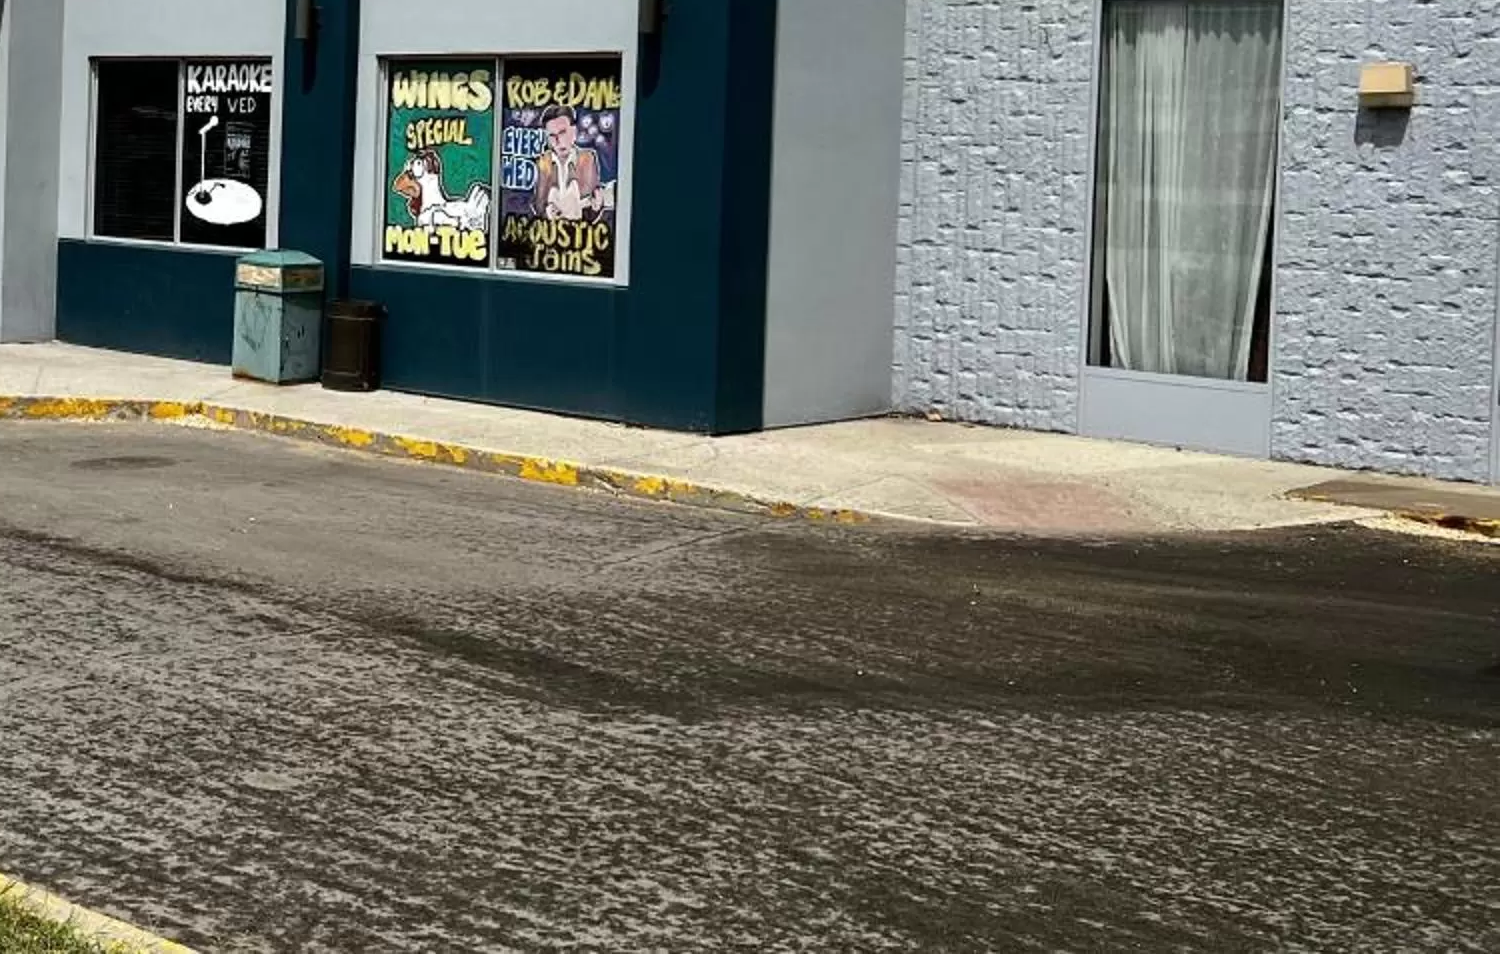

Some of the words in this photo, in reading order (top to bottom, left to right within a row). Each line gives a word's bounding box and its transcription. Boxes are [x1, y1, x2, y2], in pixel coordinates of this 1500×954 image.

[187, 64, 272, 94] KARAOKE
[392, 69, 492, 111] WINGS
[506, 76, 551, 108] ROB
[553, 79, 569, 106] &
[186, 95, 218, 113] EVERY
[406, 118, 473, 148] SPECIAL
[502, 127, 547, 157] EVERY
[501, 154, 537, 190] WED
